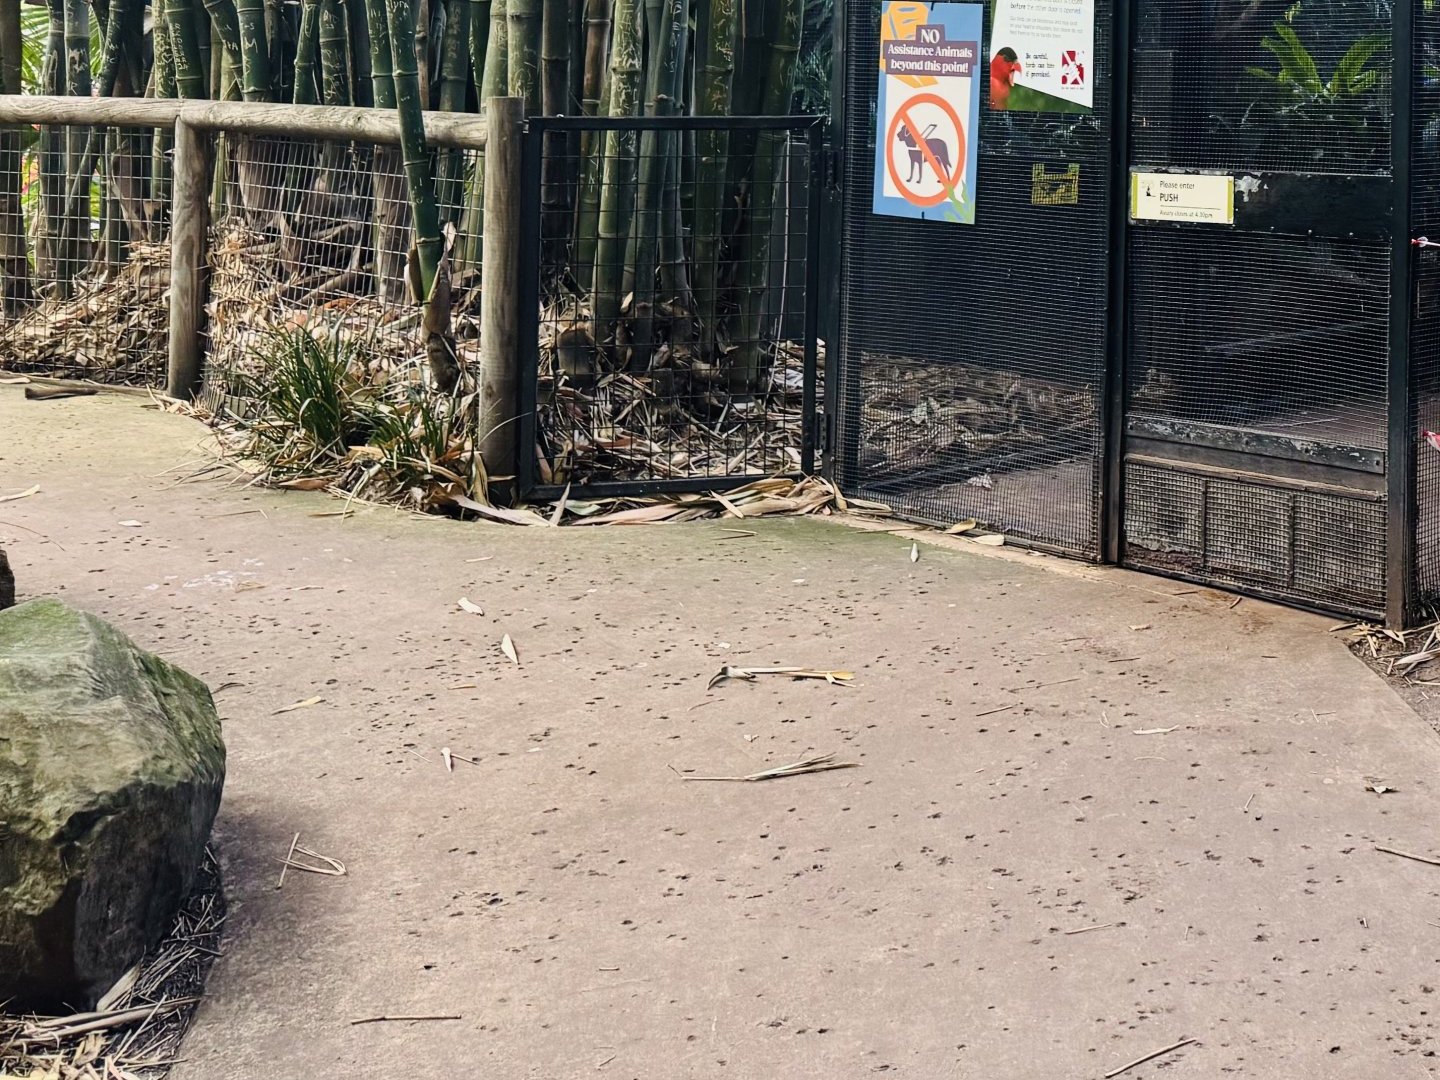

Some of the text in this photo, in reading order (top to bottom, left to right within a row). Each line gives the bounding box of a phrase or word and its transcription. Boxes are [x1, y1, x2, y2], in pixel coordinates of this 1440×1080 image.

[920, 29, 940, 44] NO
[887, 44, 973, 58] Assistance Animals
[890, 59, 969, 74] beyond this point!
[1160, 180, 1195, 190] Please enter
[1160, 193, 1179, 202] PUSH
